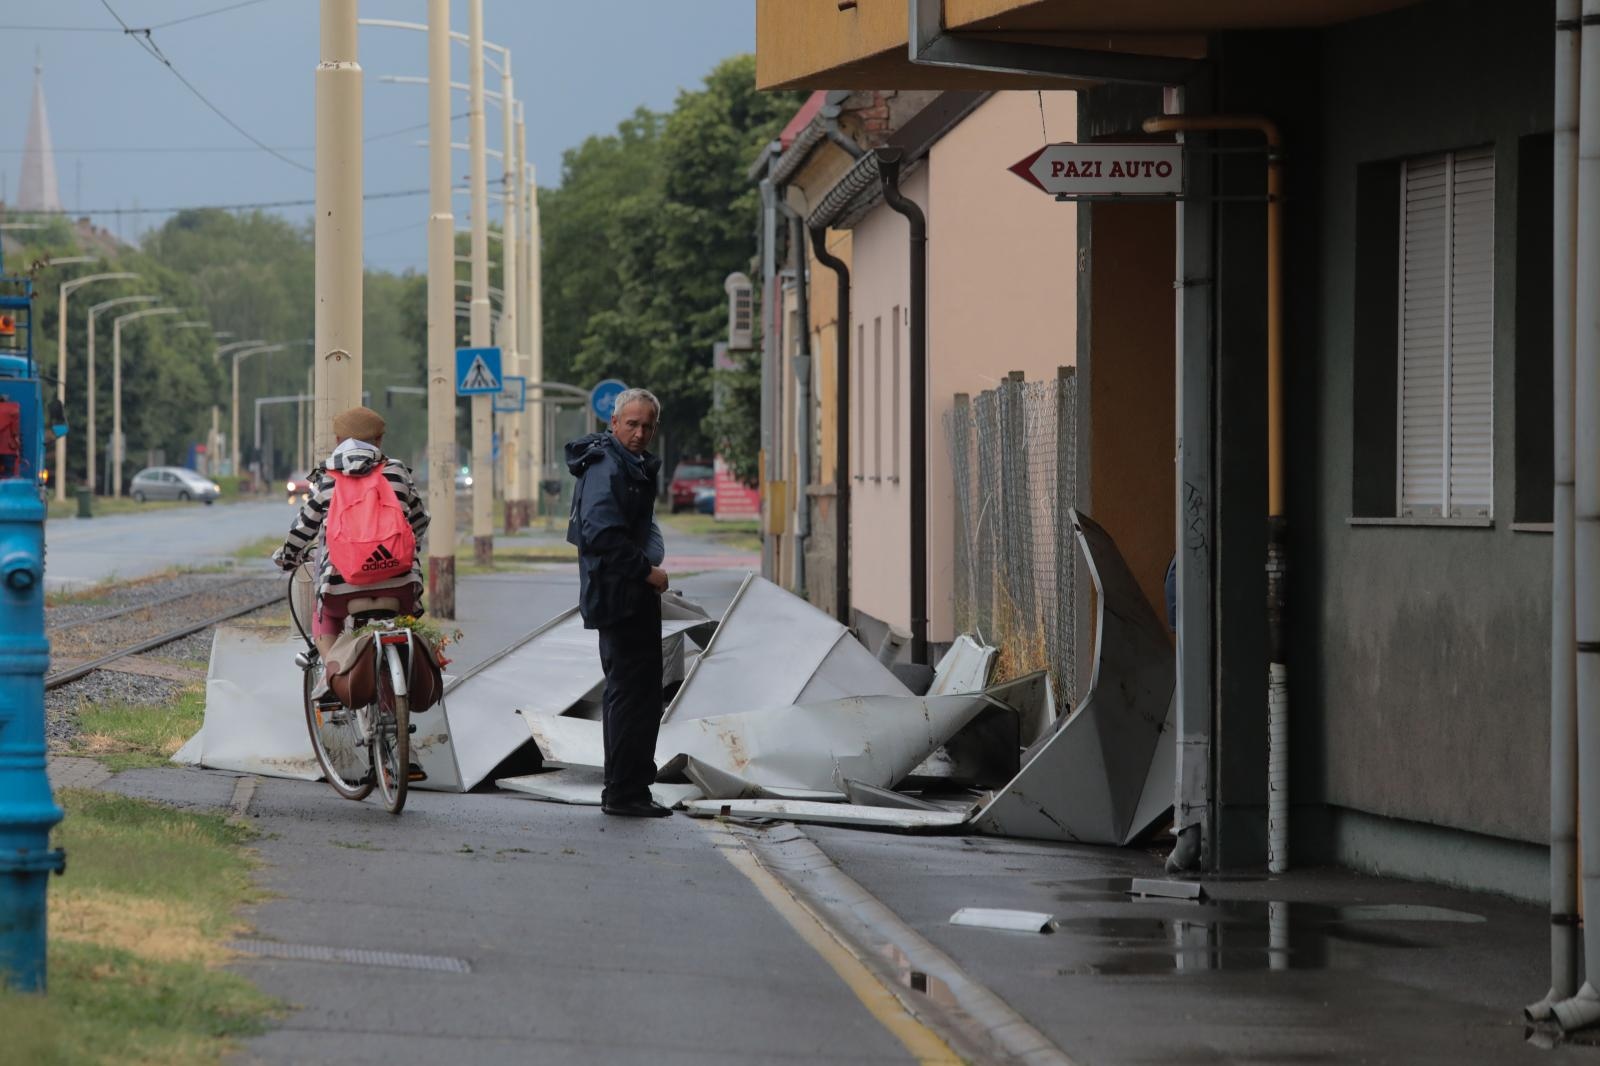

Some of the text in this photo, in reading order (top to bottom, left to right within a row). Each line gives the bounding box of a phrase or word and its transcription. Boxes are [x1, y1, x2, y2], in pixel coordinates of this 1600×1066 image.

[1051, 161, 1173, 178] PAZI AUTO
[361, 559, 400, 571] adidas
